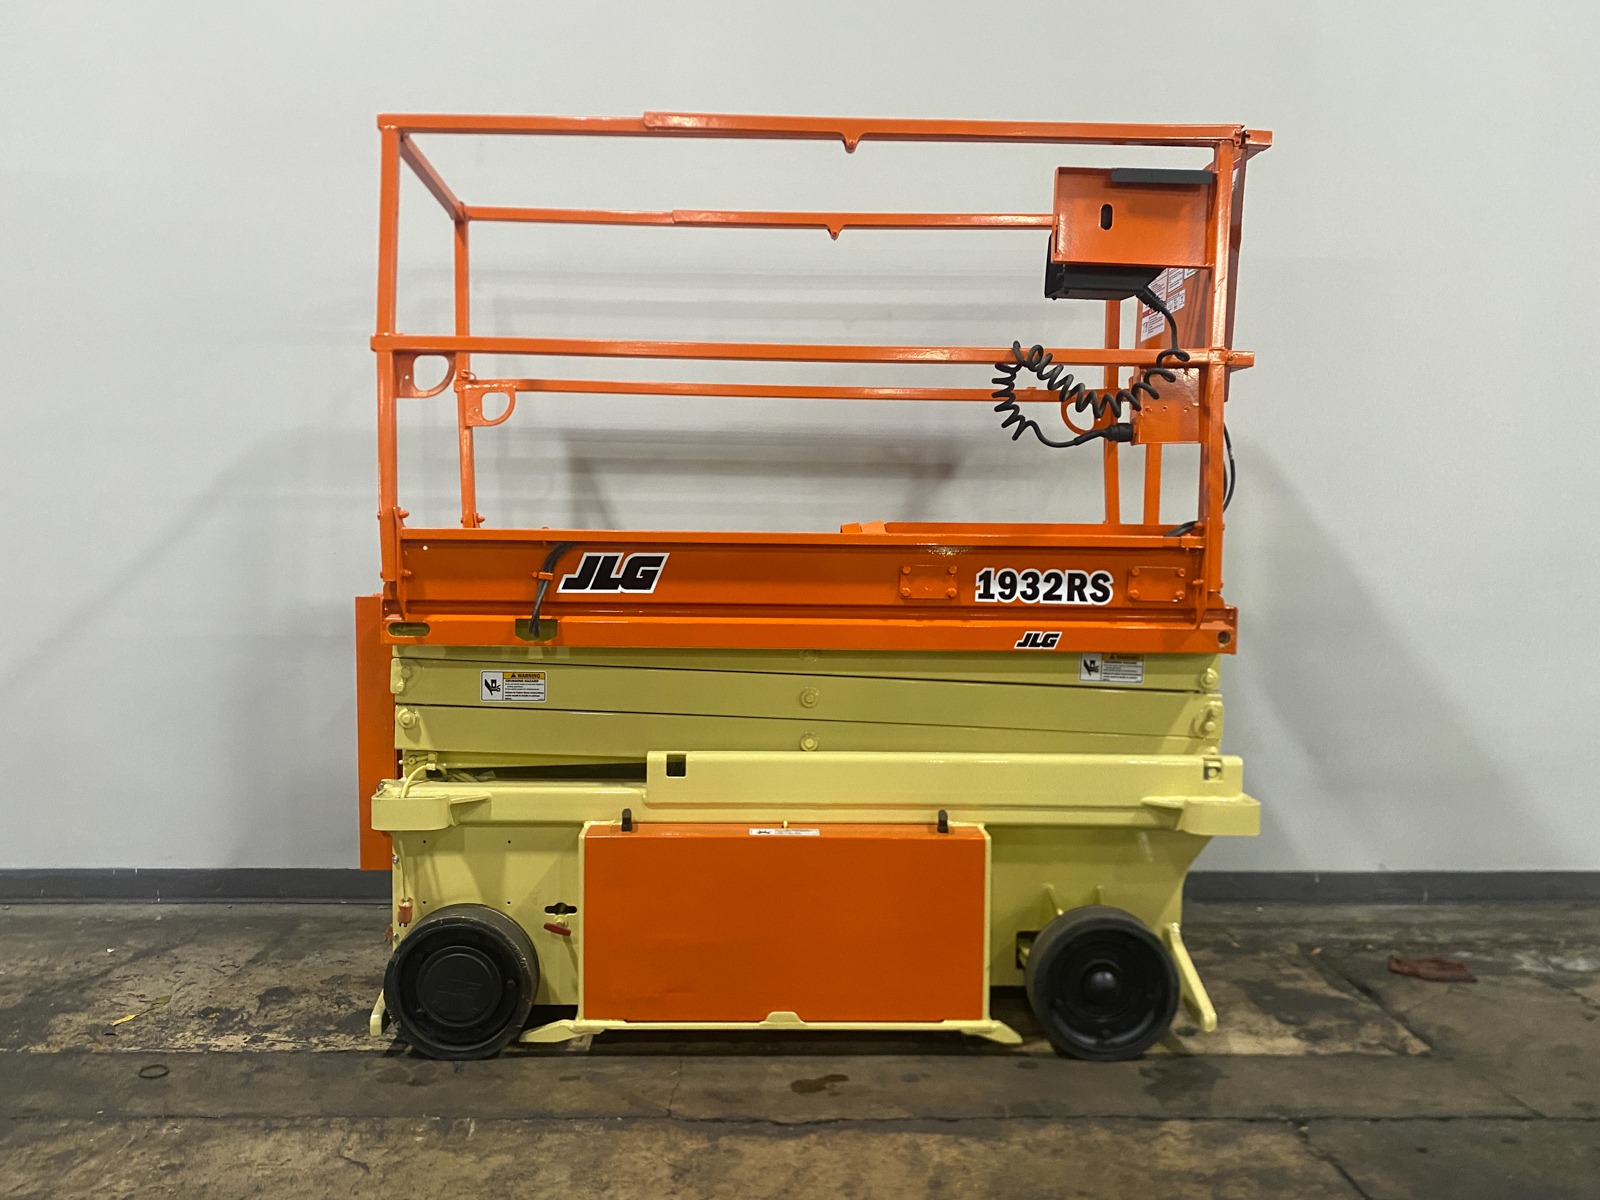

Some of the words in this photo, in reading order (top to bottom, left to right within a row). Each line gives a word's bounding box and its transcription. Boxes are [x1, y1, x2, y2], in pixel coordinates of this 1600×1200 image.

[558, 553, 668, 592] JLG
[976, 568, 1113, 605] 1932RS
[1015, 632, 1061, 649] JLG
